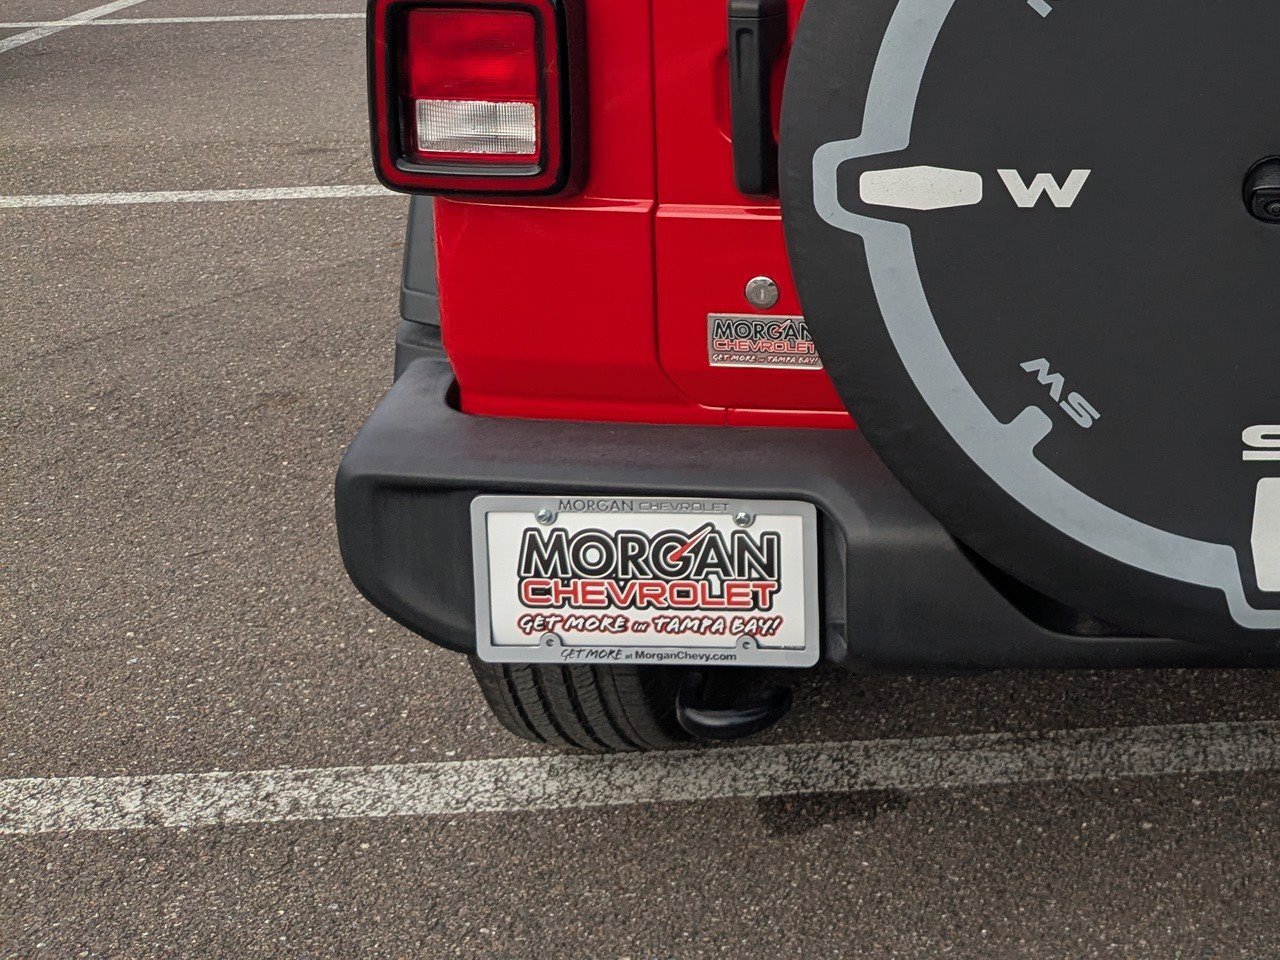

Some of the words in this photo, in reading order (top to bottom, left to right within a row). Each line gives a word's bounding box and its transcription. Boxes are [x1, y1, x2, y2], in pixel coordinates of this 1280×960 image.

[997, 169, 1091, 208] W
[713, 339, 815, 353] CHEVROLET
[767, 355, 796, 365] TAMPA
[558, 499, 634, 512] MORGAN
[639, 502, 730, 512] CHEVROLET
[518, 524, 781, 581] MORGAN
[520, 578, 780, 611] CHEVROLET
[518, 613, 562, 635] GET
[561, 615, 628, 634] MORE
[652, 616, 726, 636] TAMPA
[729, 616, 783, 638] BAY!
[560, 649, 586, 660] GET
[586, 649, 623, 660] MORE
[635, 651, 737, 662] MorganChevy.com
